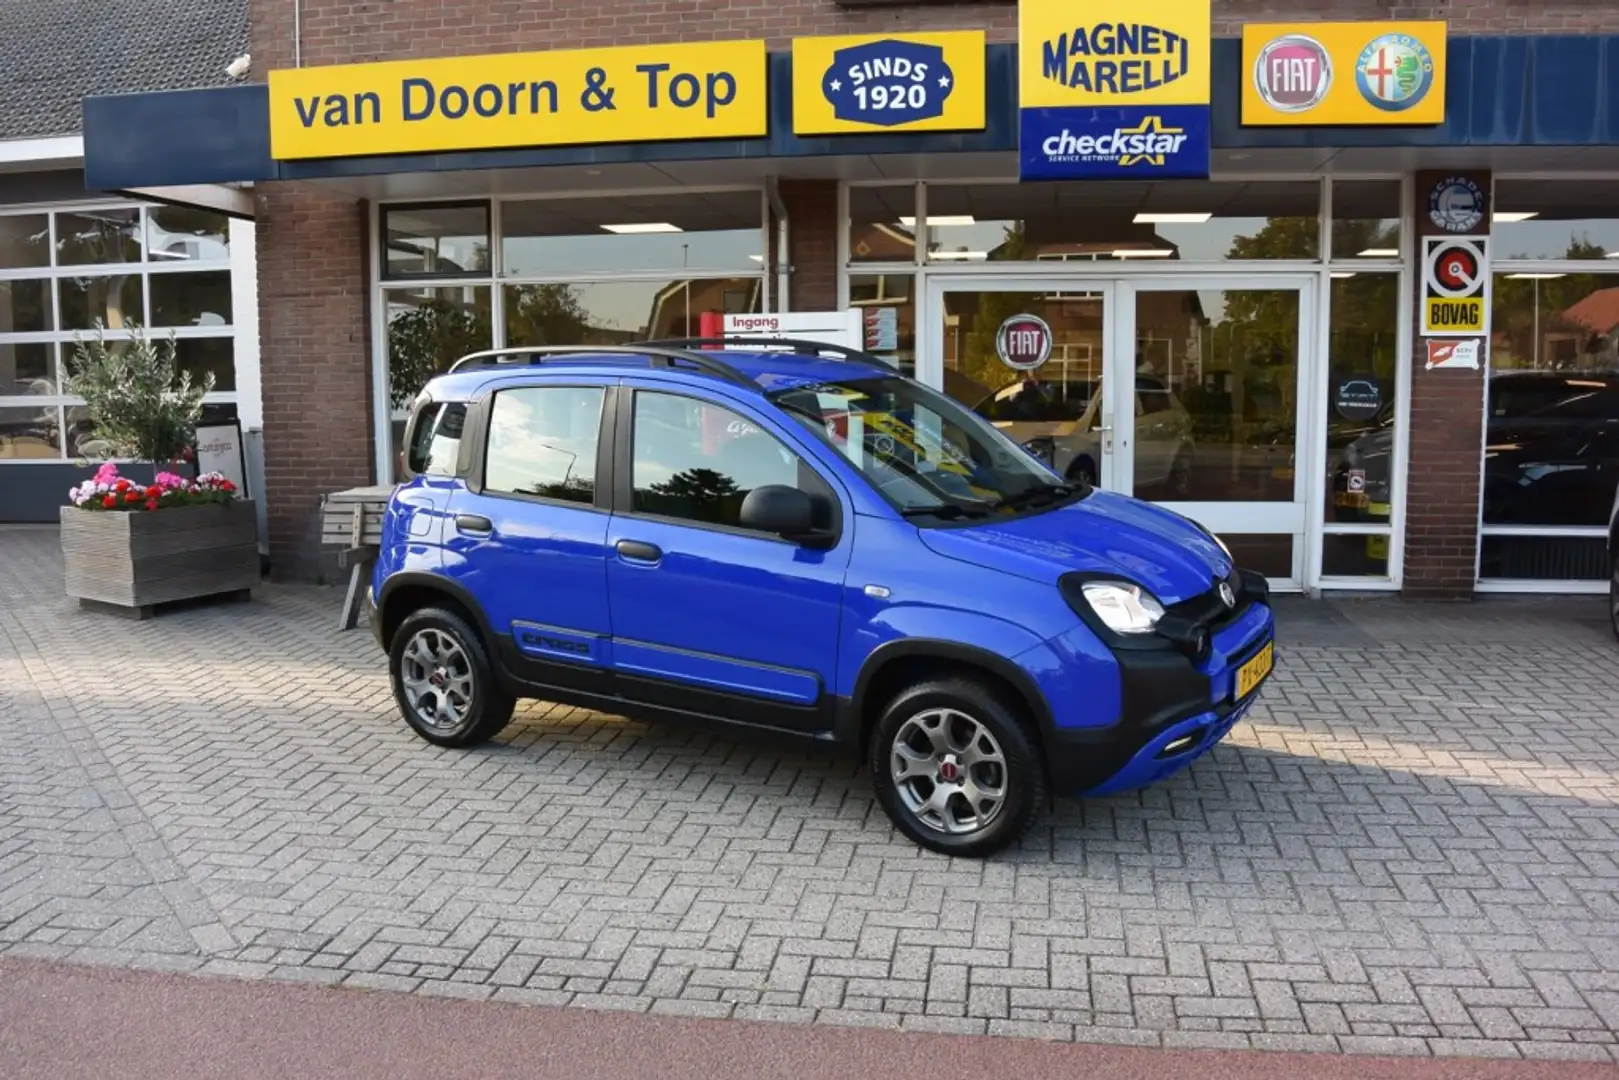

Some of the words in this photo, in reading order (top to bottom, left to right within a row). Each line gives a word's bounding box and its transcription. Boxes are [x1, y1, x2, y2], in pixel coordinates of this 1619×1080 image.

[1043, 23, 1188, 62] MAGNETI
[848, 57, 929, 86] SINDS
[1043, 53, 1188, 93] MARELLI
[1272, 58, 1316, 92] FIAT
[294, 91, 381, 128] van
[401, 77, 559, 122] Doorn
[580, 67, 617, 112] &
[636, 63, 737, 118] Top
[853, 84, 927, 110] 1920
[1042, 128, 1187, 155] checkstar
[1048, 154, 1079, 162] SERVICE
[1082, 153, 1120, 161] NETWORK
[732, 316, 779, 329] Ingang
[1431, 303, 1479, 325] BOVAG
[1009, 330, 1040, 355] FIAT
